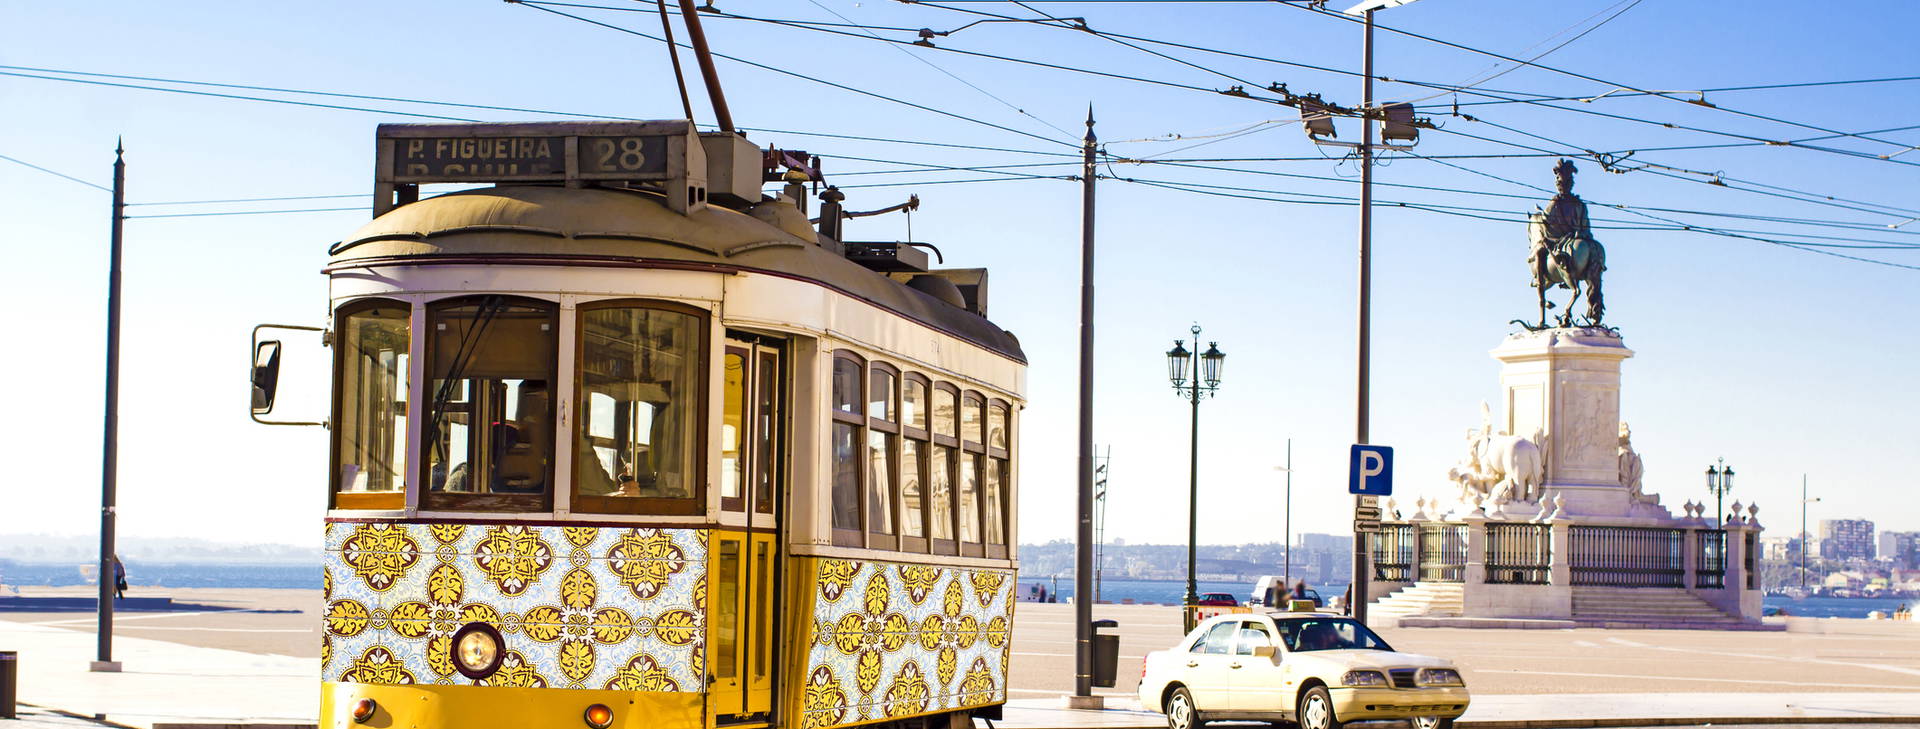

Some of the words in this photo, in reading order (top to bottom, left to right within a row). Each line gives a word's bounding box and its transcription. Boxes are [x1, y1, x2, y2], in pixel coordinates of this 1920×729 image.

[407, 138, 425, 159] P.
[435, 137, 552, 159] FIGUEIRA
[598, 137, 645, 171] 28
[1359, 450, 1384, 490] P
